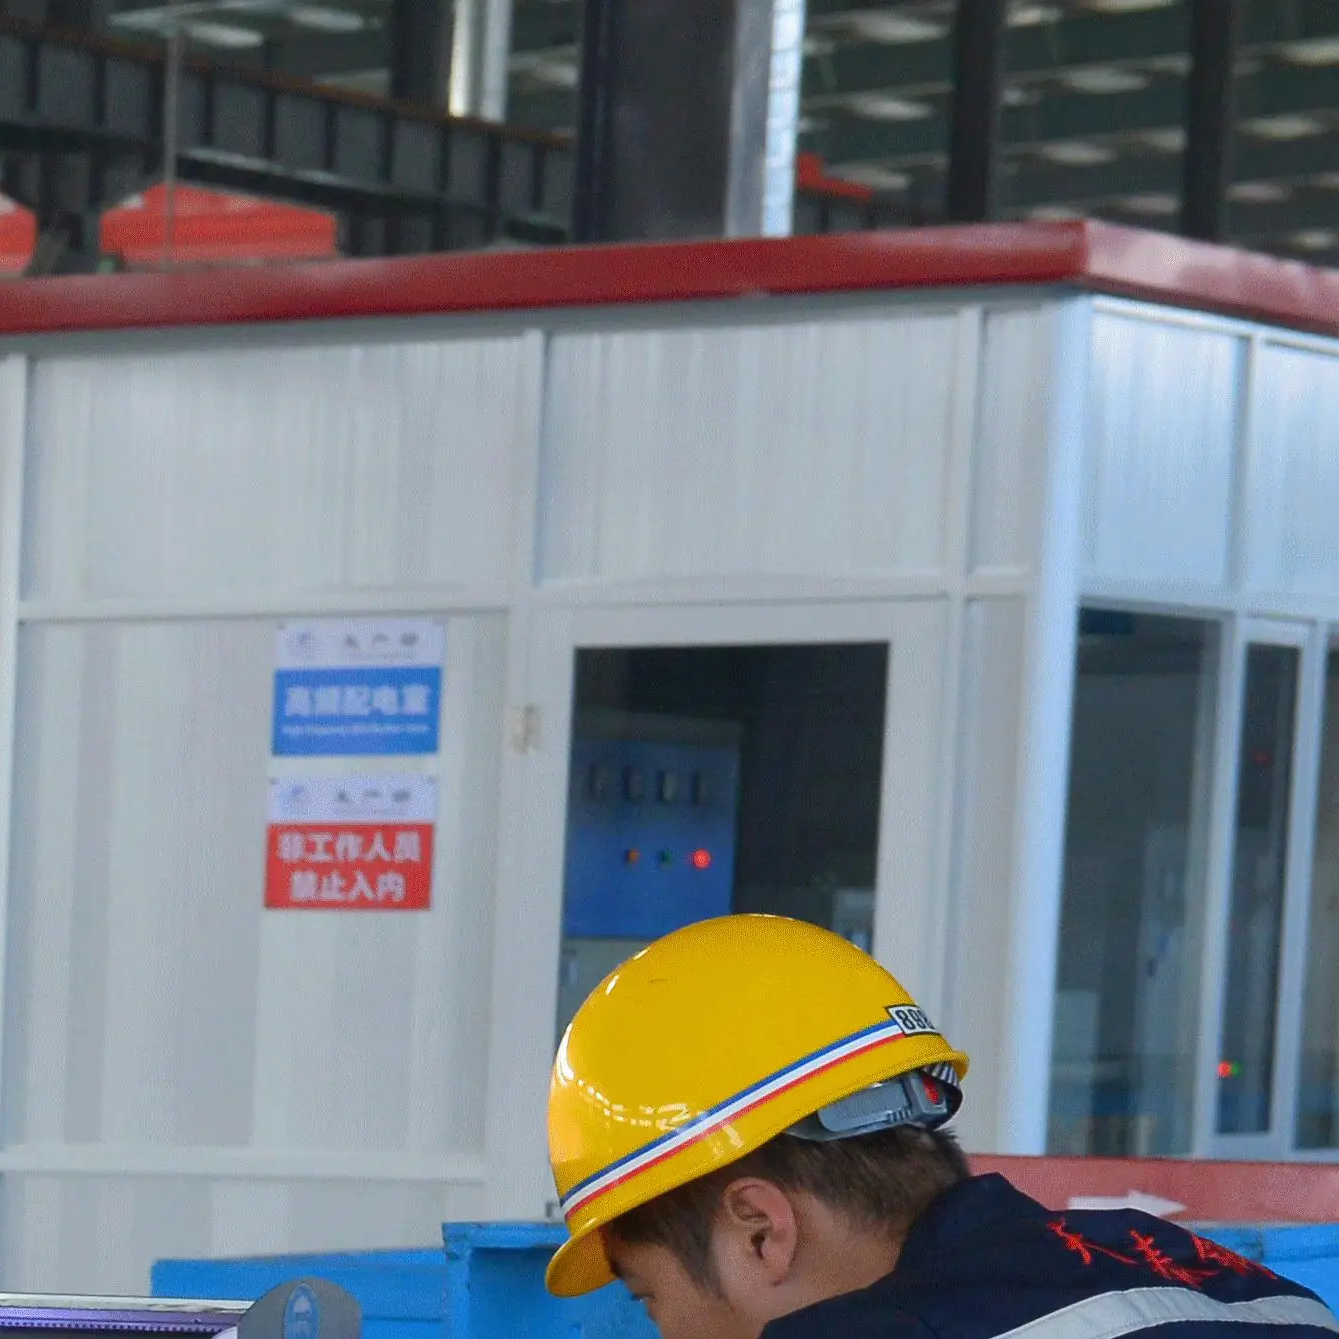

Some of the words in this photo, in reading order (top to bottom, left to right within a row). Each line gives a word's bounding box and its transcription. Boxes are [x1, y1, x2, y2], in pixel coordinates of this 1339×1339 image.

[277, 830, 422, 863] 非工作人员
[290, 870, 406, 903] 禁止入内
